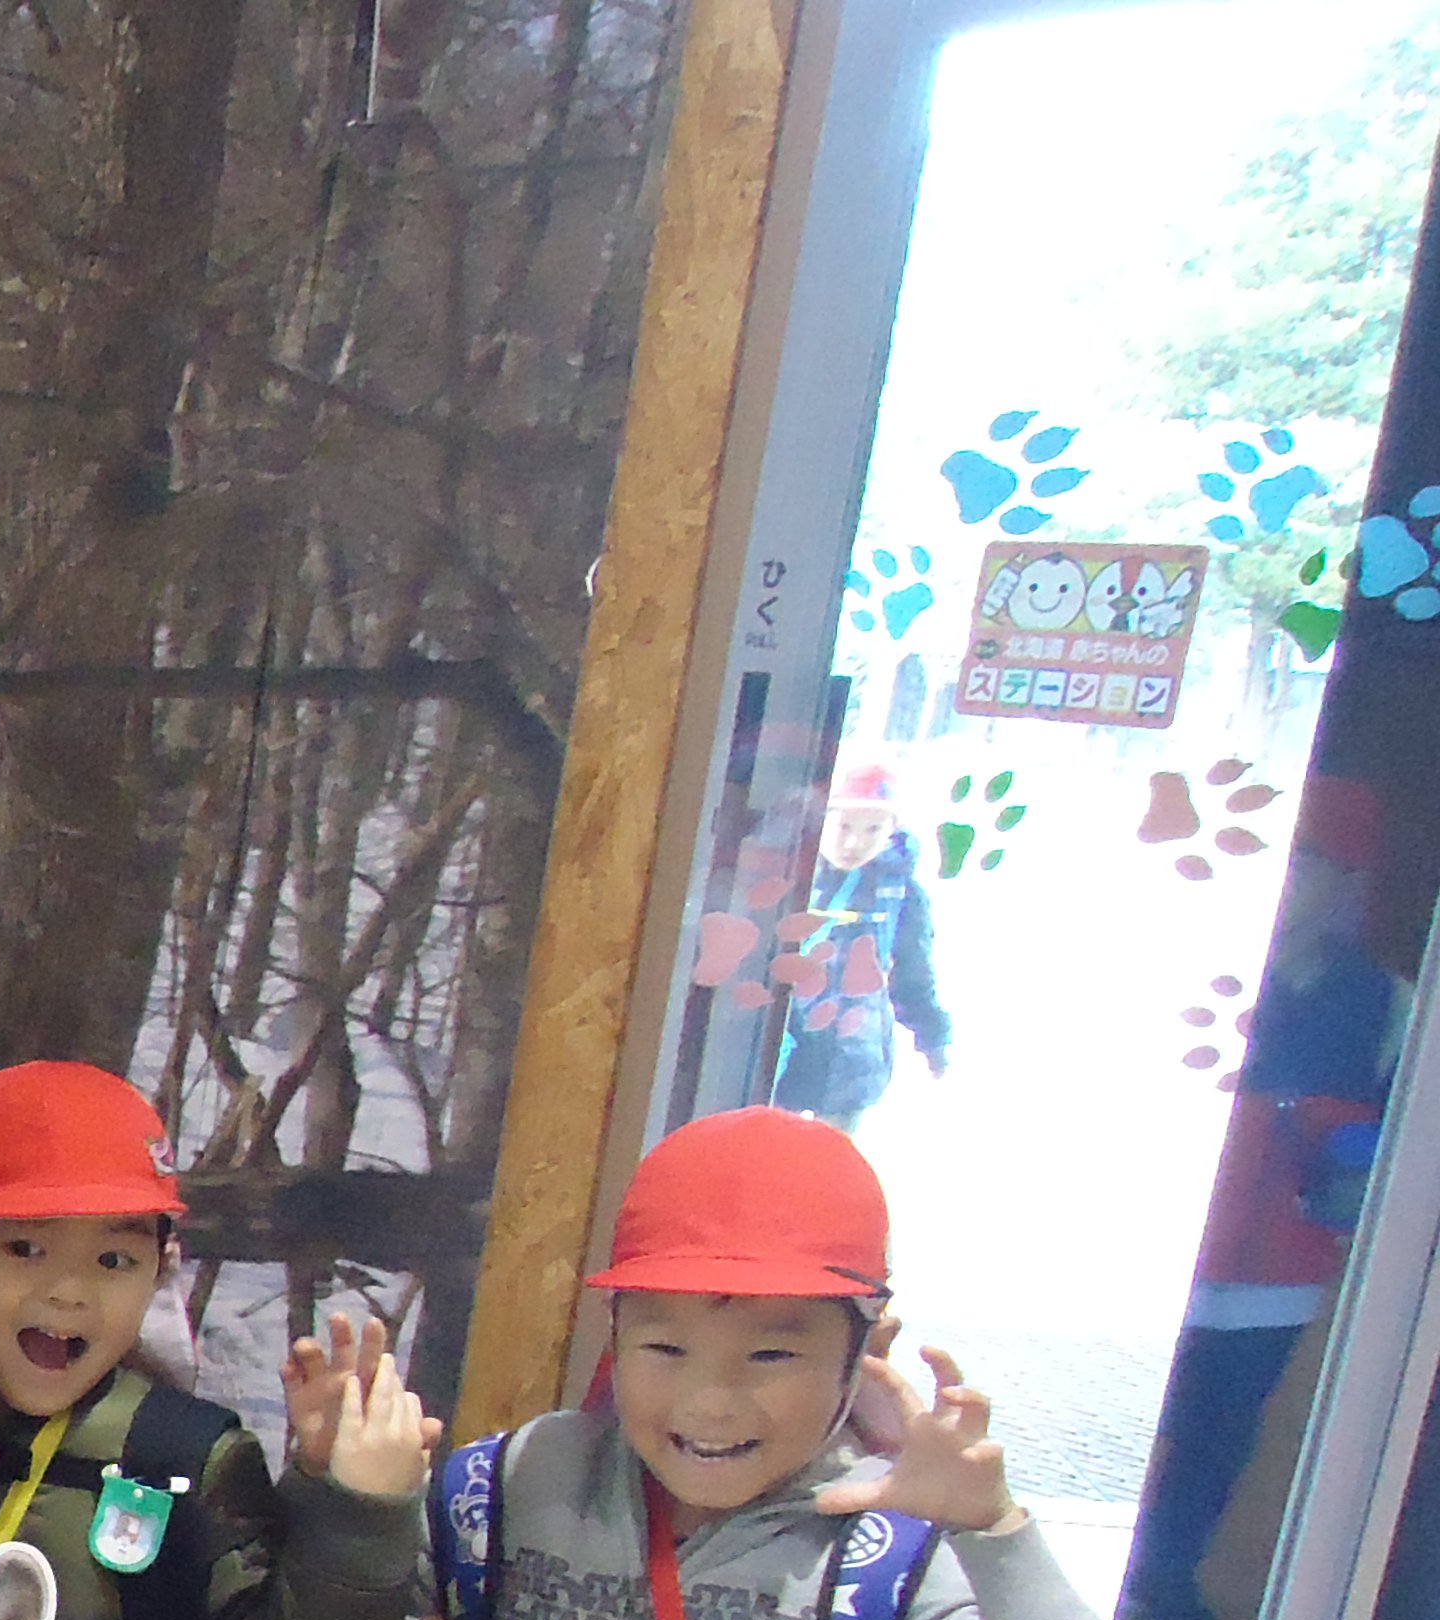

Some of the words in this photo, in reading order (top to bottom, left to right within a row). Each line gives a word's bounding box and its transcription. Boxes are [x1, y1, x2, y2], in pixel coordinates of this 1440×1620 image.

[756, 559, 788, 626] ひく
[968, 669, 1167, 710] ステーション
